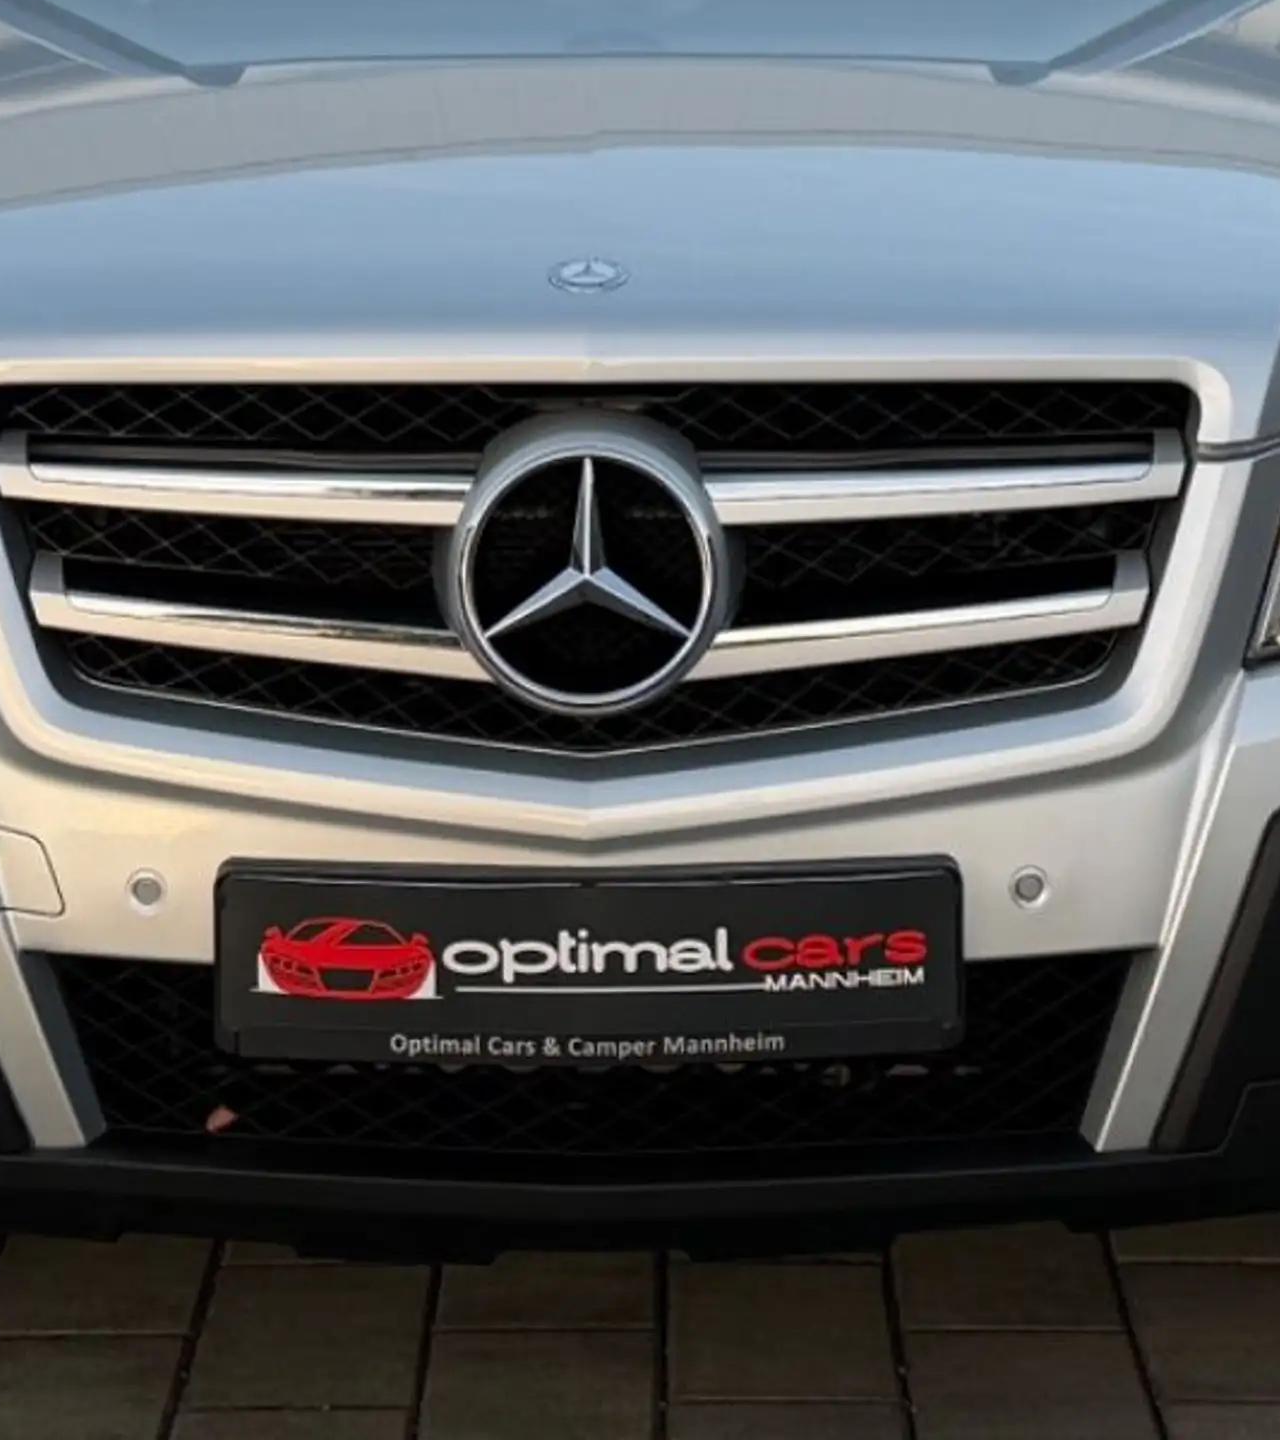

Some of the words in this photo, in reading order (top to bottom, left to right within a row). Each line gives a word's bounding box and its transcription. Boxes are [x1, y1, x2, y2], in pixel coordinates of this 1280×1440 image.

[764, 966, 925, 993] MANNHEIM
[389, 1033, 481, 1058] Optimal
[487, 1036, 537, 1057] Cars
[543, 1036, 562, 1058] &
[568, 1036, 657, 1060] Camper
[663, 1031, 786, 1055] Mannheim
